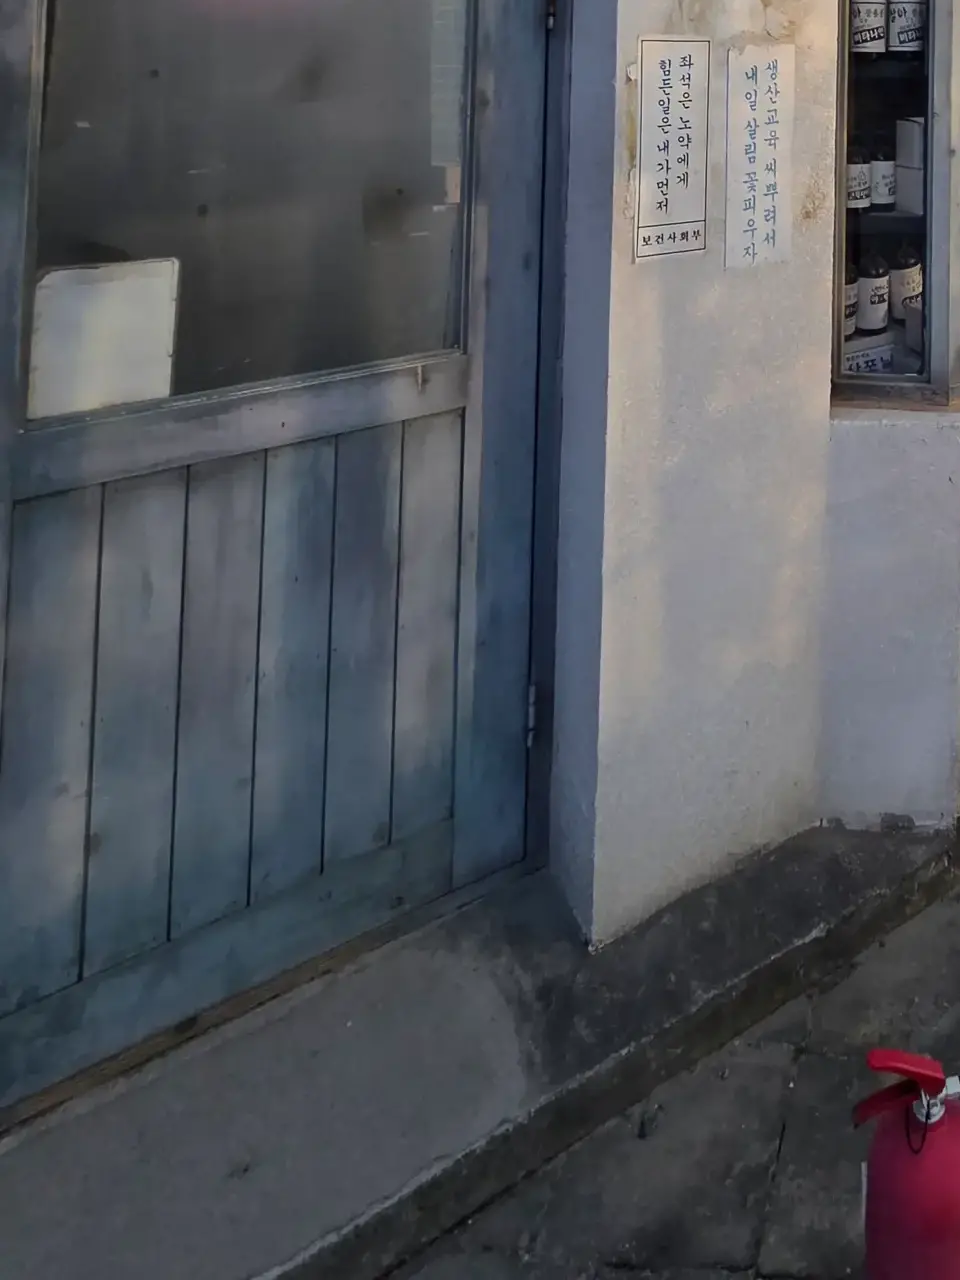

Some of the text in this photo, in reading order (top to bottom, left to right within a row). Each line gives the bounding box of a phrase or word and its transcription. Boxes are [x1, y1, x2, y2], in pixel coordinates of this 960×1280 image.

[657, 59, 673, 135] 힘든일은
[676, 55, 694, 189] 좌석은 노약에게
[642, 227, 702, 247] 보건사회부
